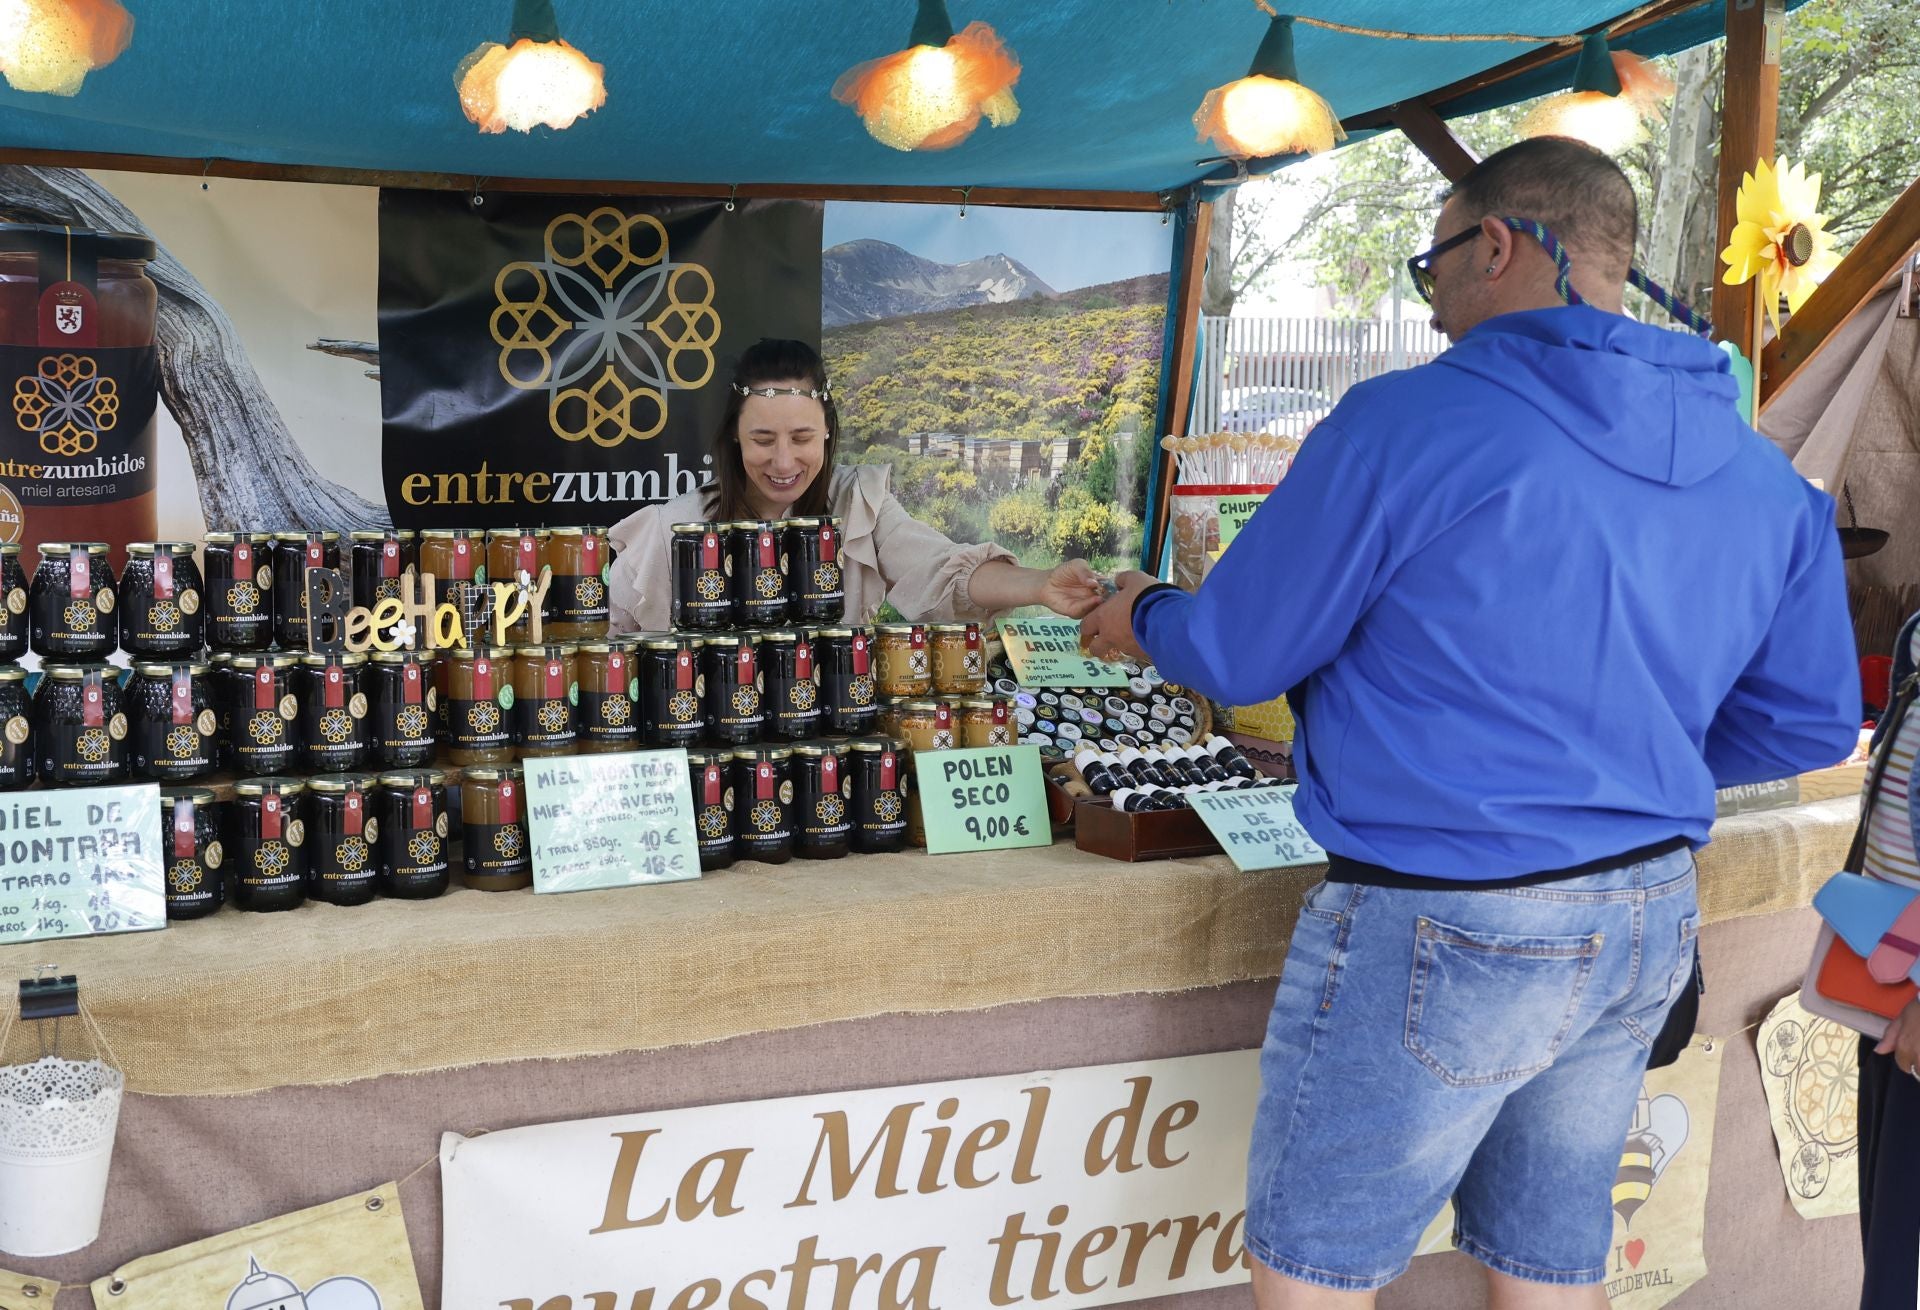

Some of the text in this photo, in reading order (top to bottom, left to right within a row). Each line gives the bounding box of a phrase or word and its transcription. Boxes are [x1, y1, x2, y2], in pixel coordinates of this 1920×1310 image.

[21, 484, 116, 497] miel artesana
[51, 632, 106, 640] entrezumbidos
[137, 632, 191, 640] entrezumbidos
[239, 743, 294, 753] entrezumbidos
[310, 741, 363, 751] entrezumbidos
[63, 761, 120, 769] entrezumbidos
[154, 757, 209, 766] entrezumbidos
[943, 754, 1013, 782] POLEN
[952, 783, 1010, 809] SECO
[87, 801, 123, 826] DE
[1242, 811, 1275, 826] DE
[535, 845, 542, 860] 1
[243, 873, 300, 885] entrezumbidos
[540, 868, 550, 879] 2
[2, 872, 71, 891] TARRO
[589, 1076, 1199, 1235] La Miel de
[1615, 1245, 1624, 1273] I
[498, 1235, 948, 1310] stra
